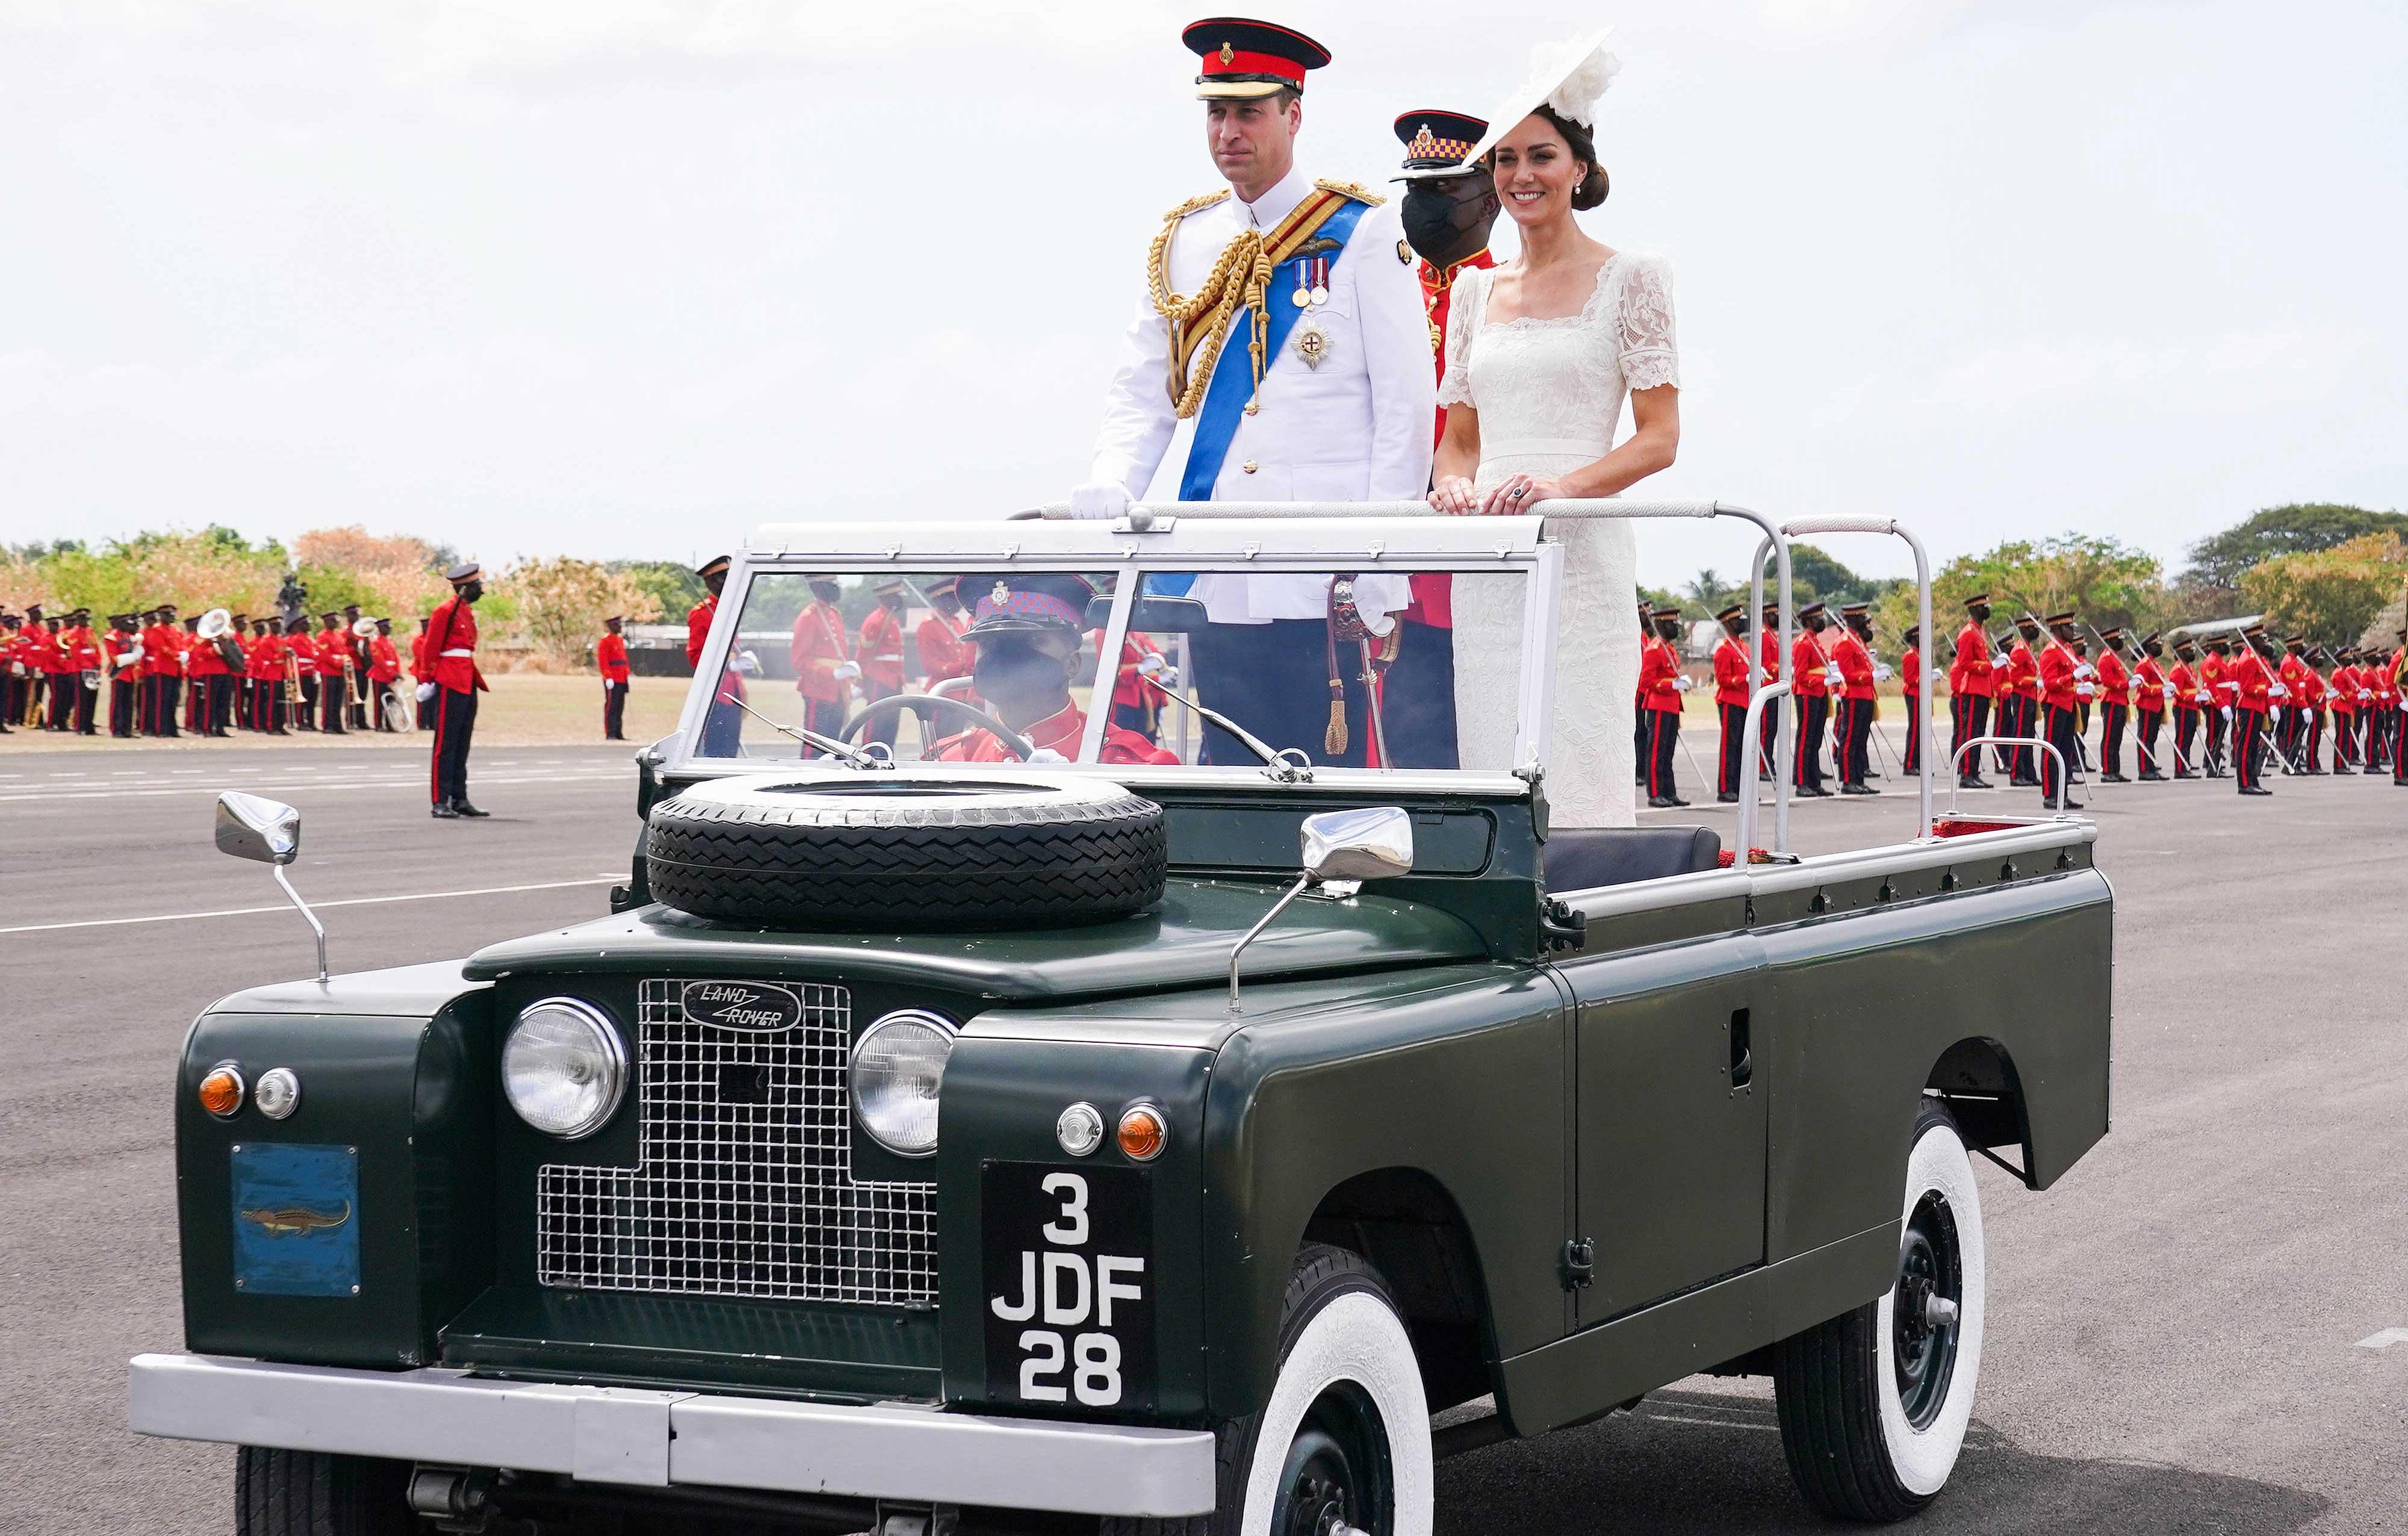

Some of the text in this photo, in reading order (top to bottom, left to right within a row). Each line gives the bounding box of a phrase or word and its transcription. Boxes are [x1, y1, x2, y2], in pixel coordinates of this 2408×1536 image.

[700, 986, 747, 1003] LAND
[726, 1009, 783, 1027] ROVER
[1041, 1172, 1090, 1245] 3
[991, 1251, 1144, 1326] JDF
[1019, 1329, 1122, 1407] 28
